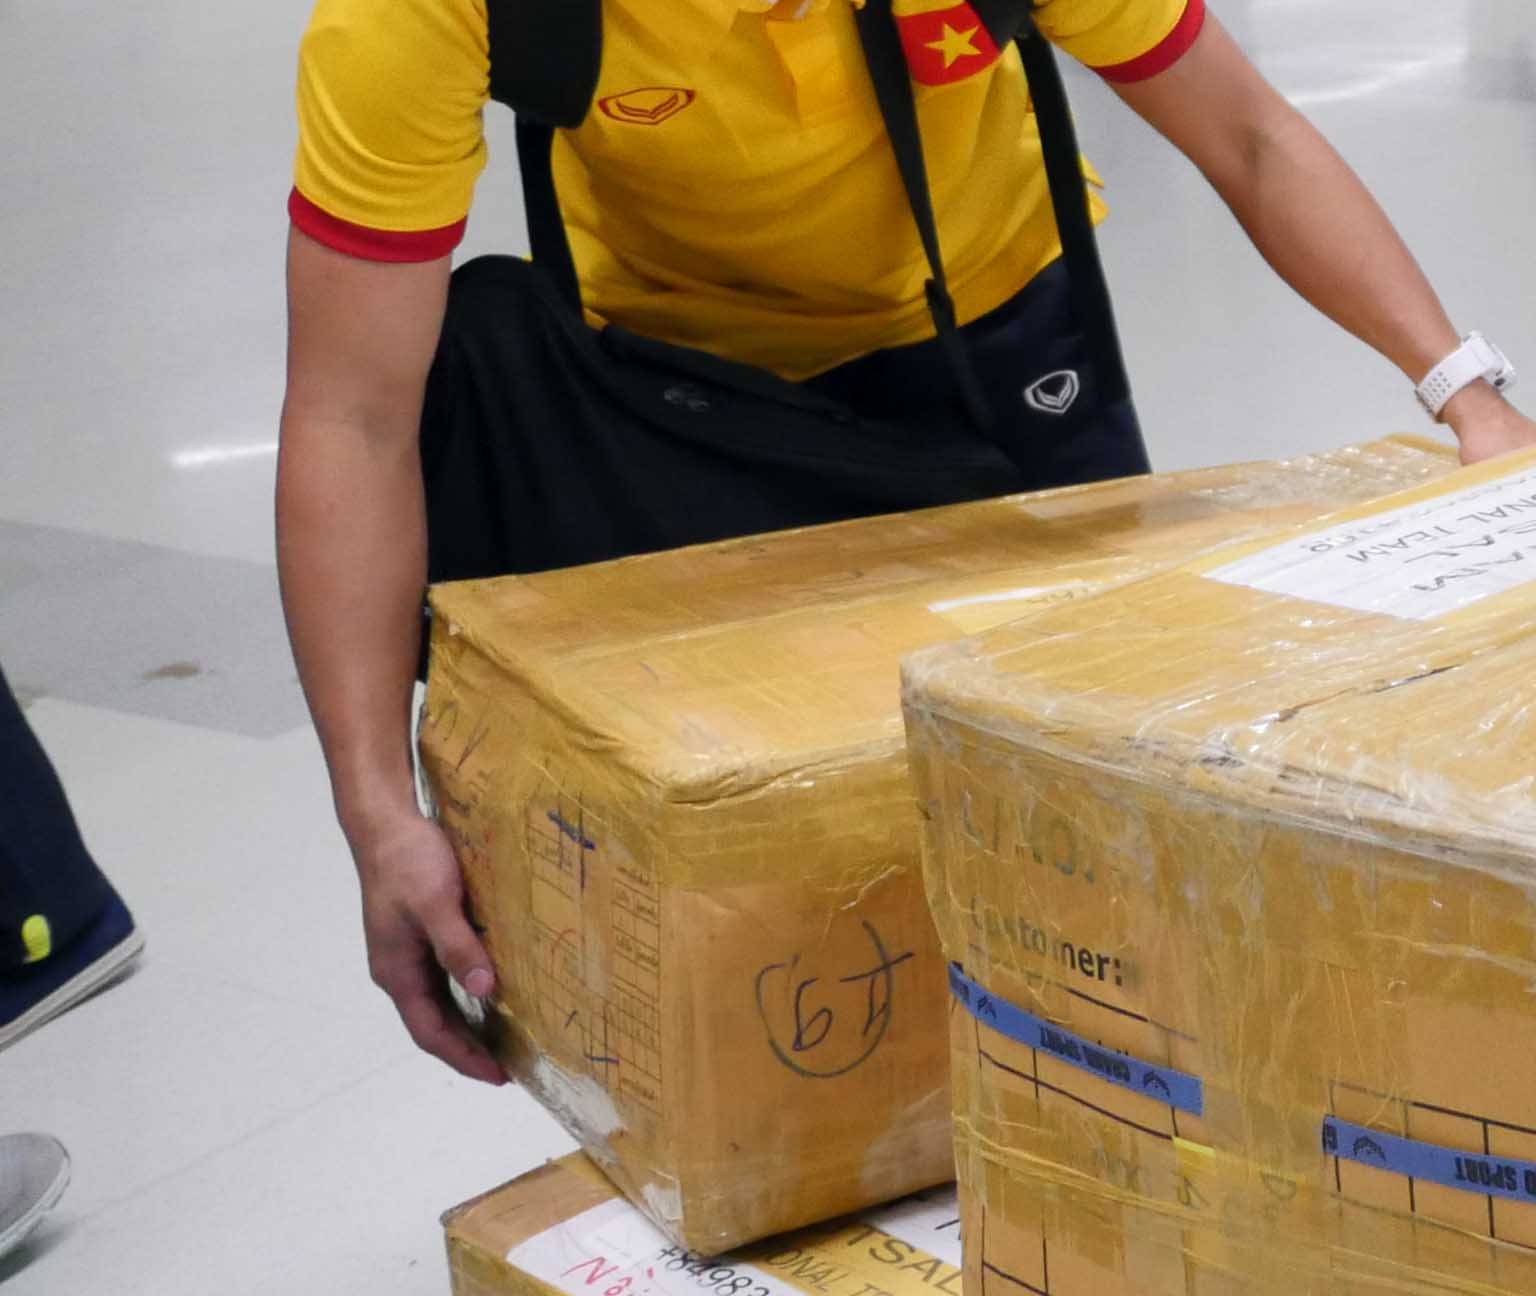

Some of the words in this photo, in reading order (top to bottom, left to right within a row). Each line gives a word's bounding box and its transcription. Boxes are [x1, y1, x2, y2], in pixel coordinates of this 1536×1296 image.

[1345, 523, 1451, 563] TEAM
[1453, 1156, 1518, 1193] SPORT
[847, 1223, 962, 1296] TSAL
